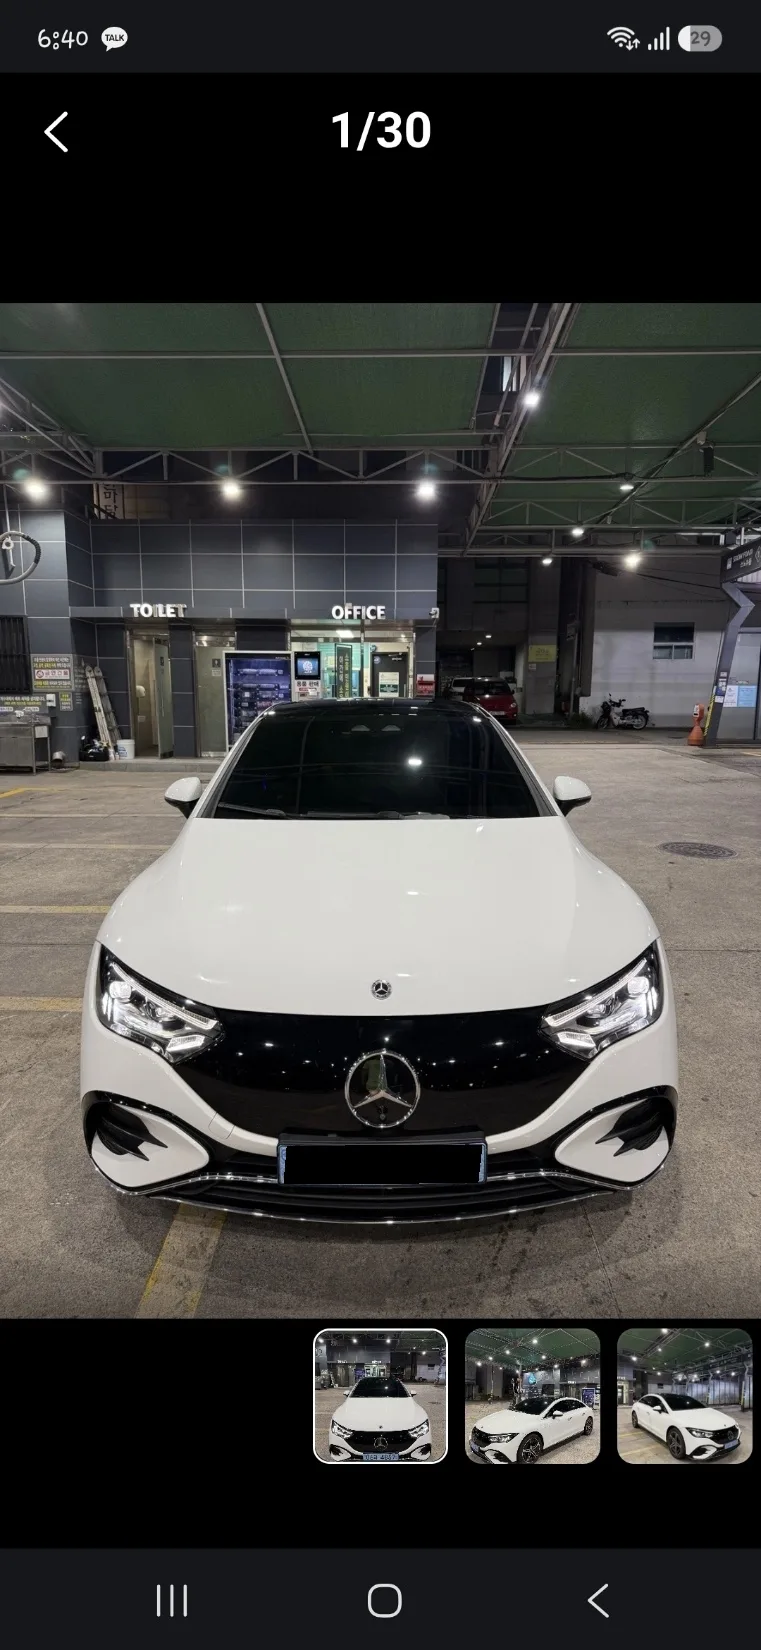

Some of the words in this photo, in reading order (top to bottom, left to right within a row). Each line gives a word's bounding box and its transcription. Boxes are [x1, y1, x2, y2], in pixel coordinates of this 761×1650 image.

[37, 29, 89, 51] 6:40
[104, 34, 125, 42] TALK
[690, 31, 711, 47] 29
[332, 111, 431, 152] 1/30
[129, 603, 187, 618] TOILET
[331, 604, 386, 620] OFFICE
